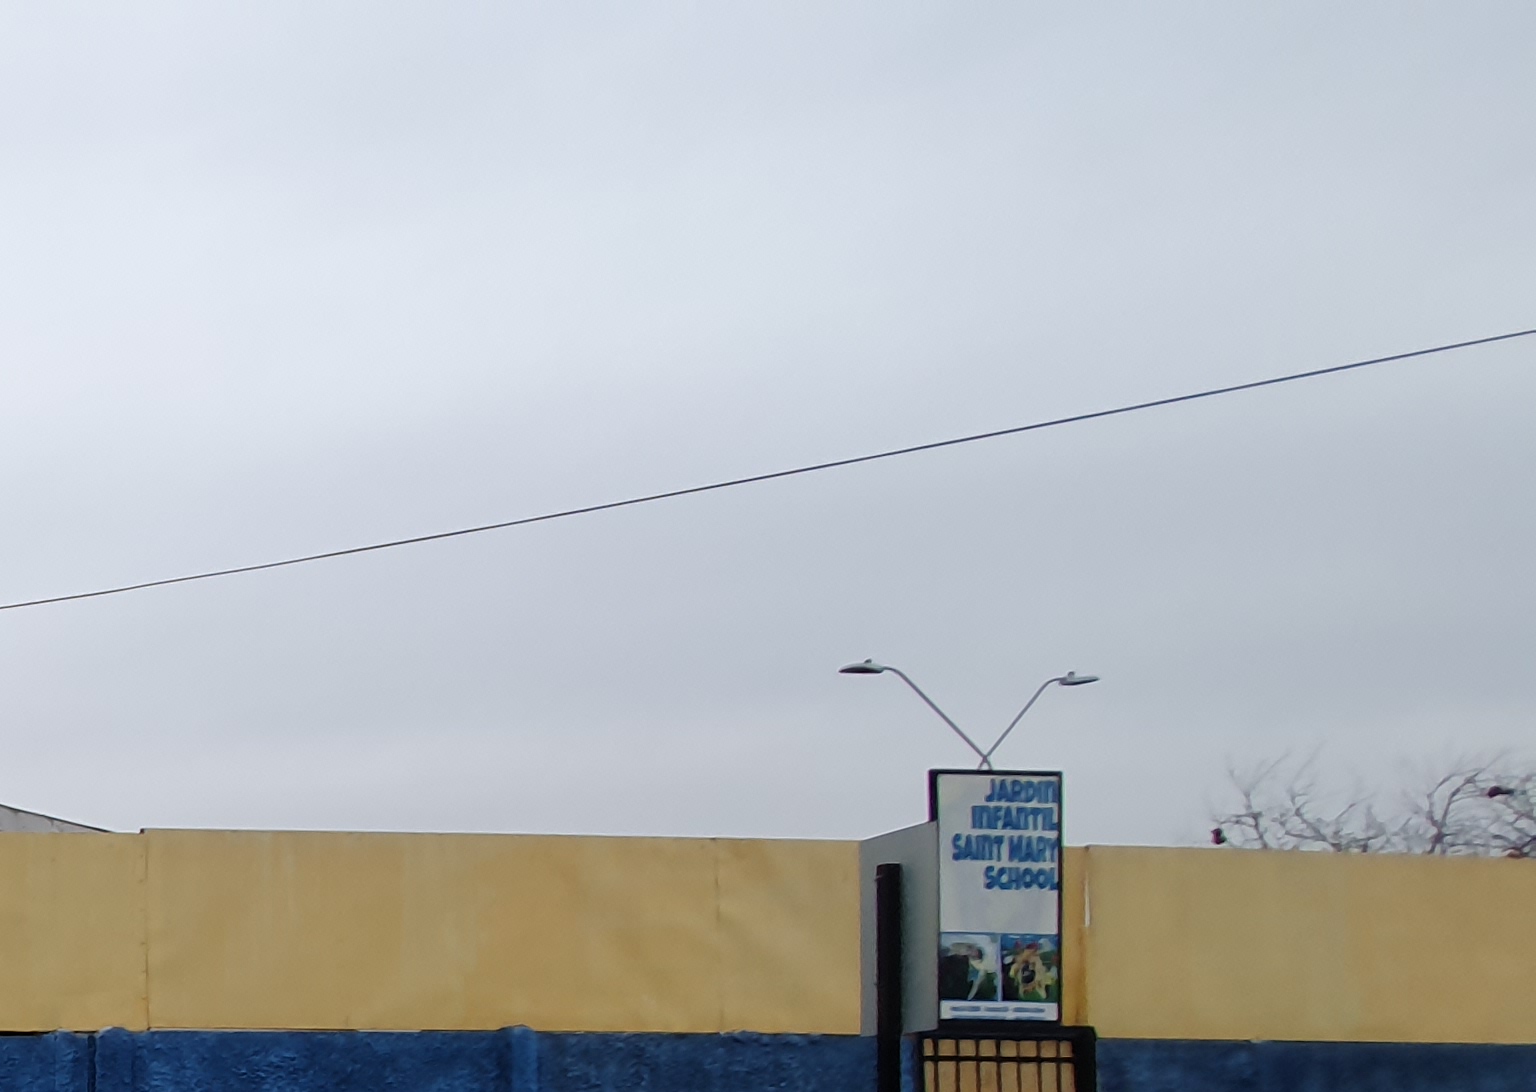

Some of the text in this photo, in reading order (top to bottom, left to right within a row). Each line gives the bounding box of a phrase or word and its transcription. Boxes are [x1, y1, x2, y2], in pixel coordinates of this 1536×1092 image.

[971, 805, 1058, 831] INFANTIL
[952, 833, 1058, 862] SAINT MARY
[984, 865, 1058, 890] SCHOOL
